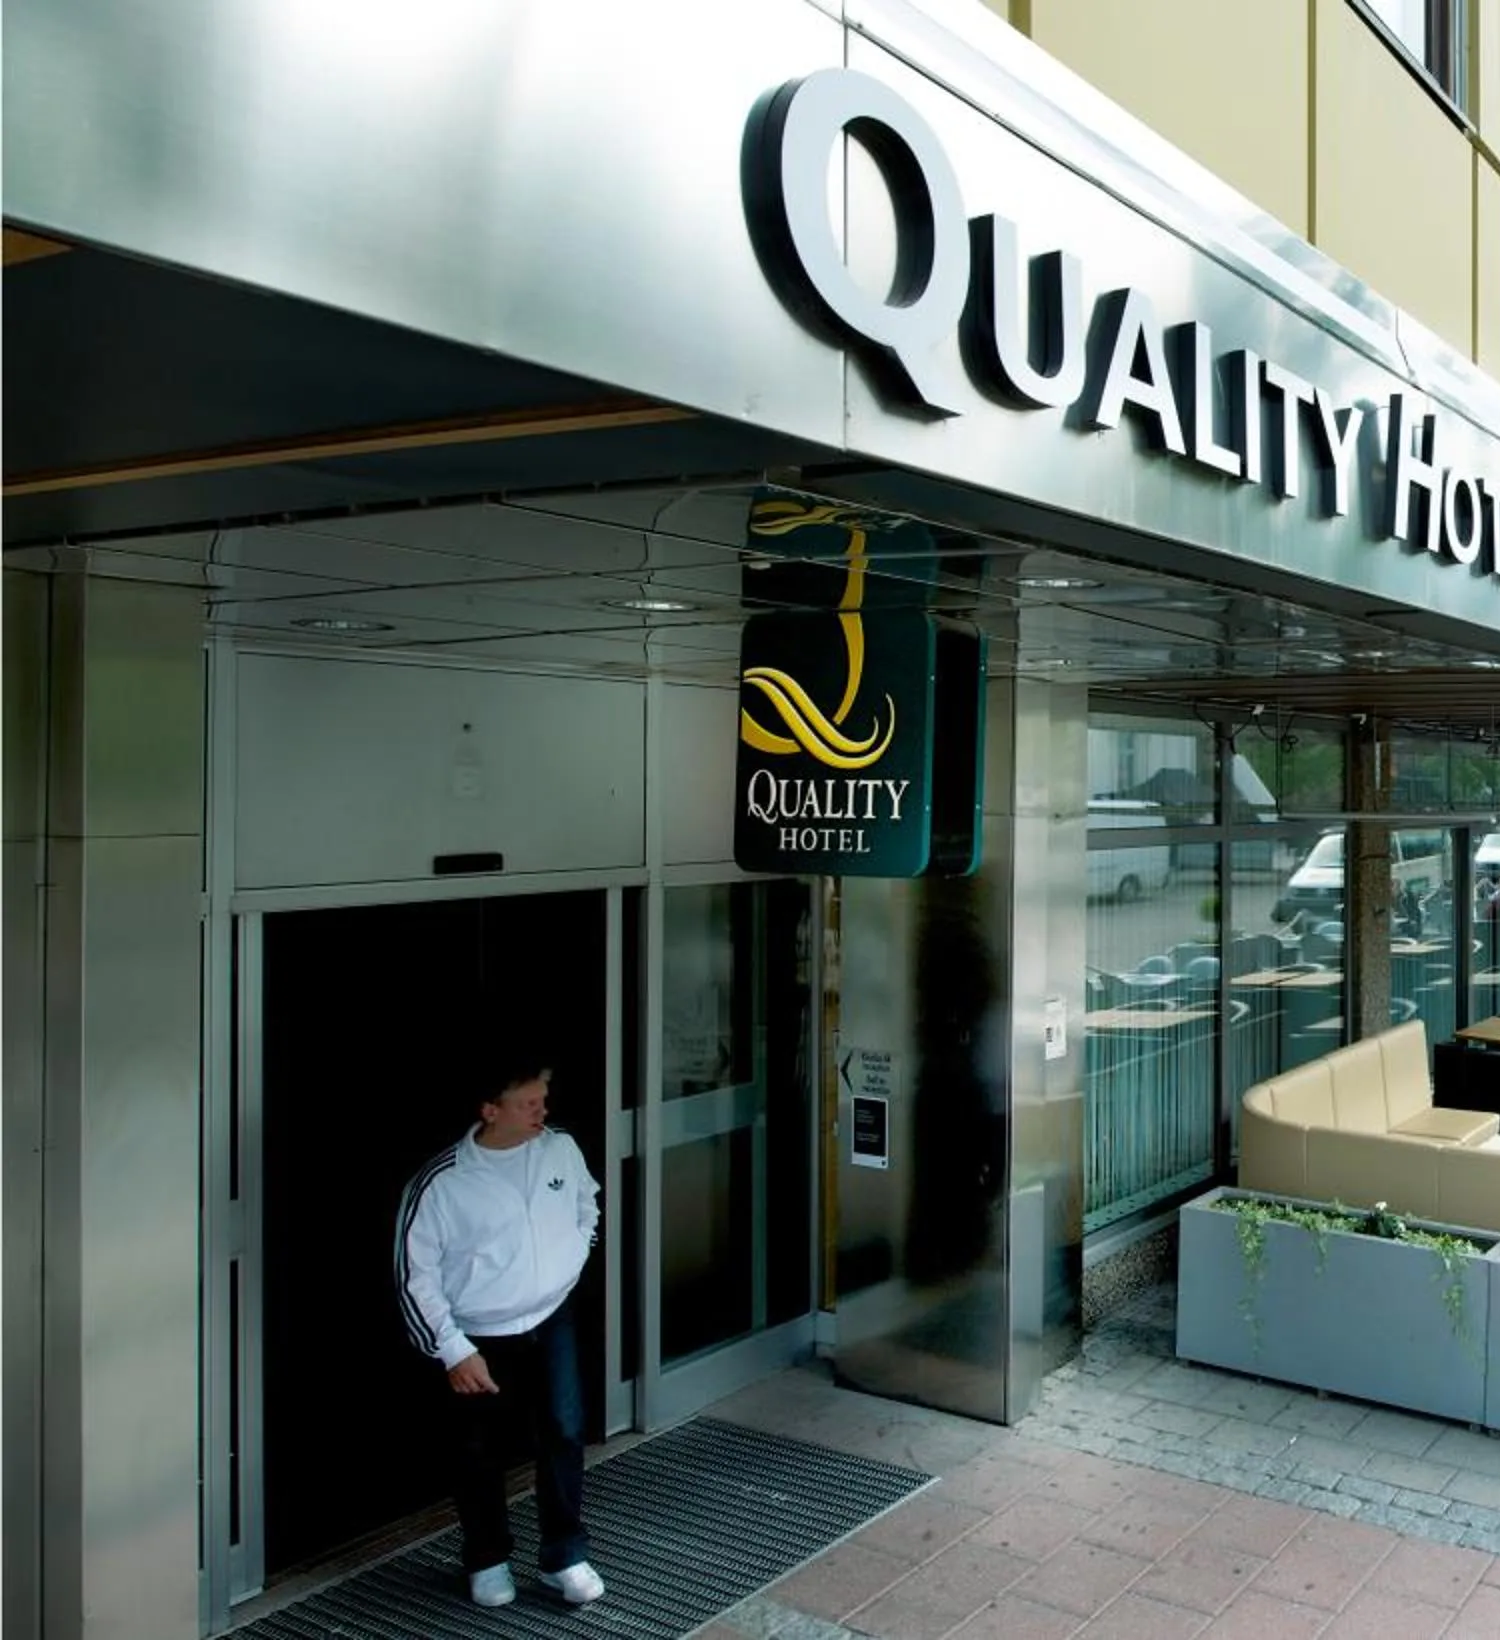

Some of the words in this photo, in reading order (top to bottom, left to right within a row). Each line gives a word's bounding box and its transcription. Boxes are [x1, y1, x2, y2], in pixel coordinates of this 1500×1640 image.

[743, 66, 1363, 518] QUALITY
[747, 768, 910, 824] QUALITY
[779, 827, 871, 853] HOTEL
